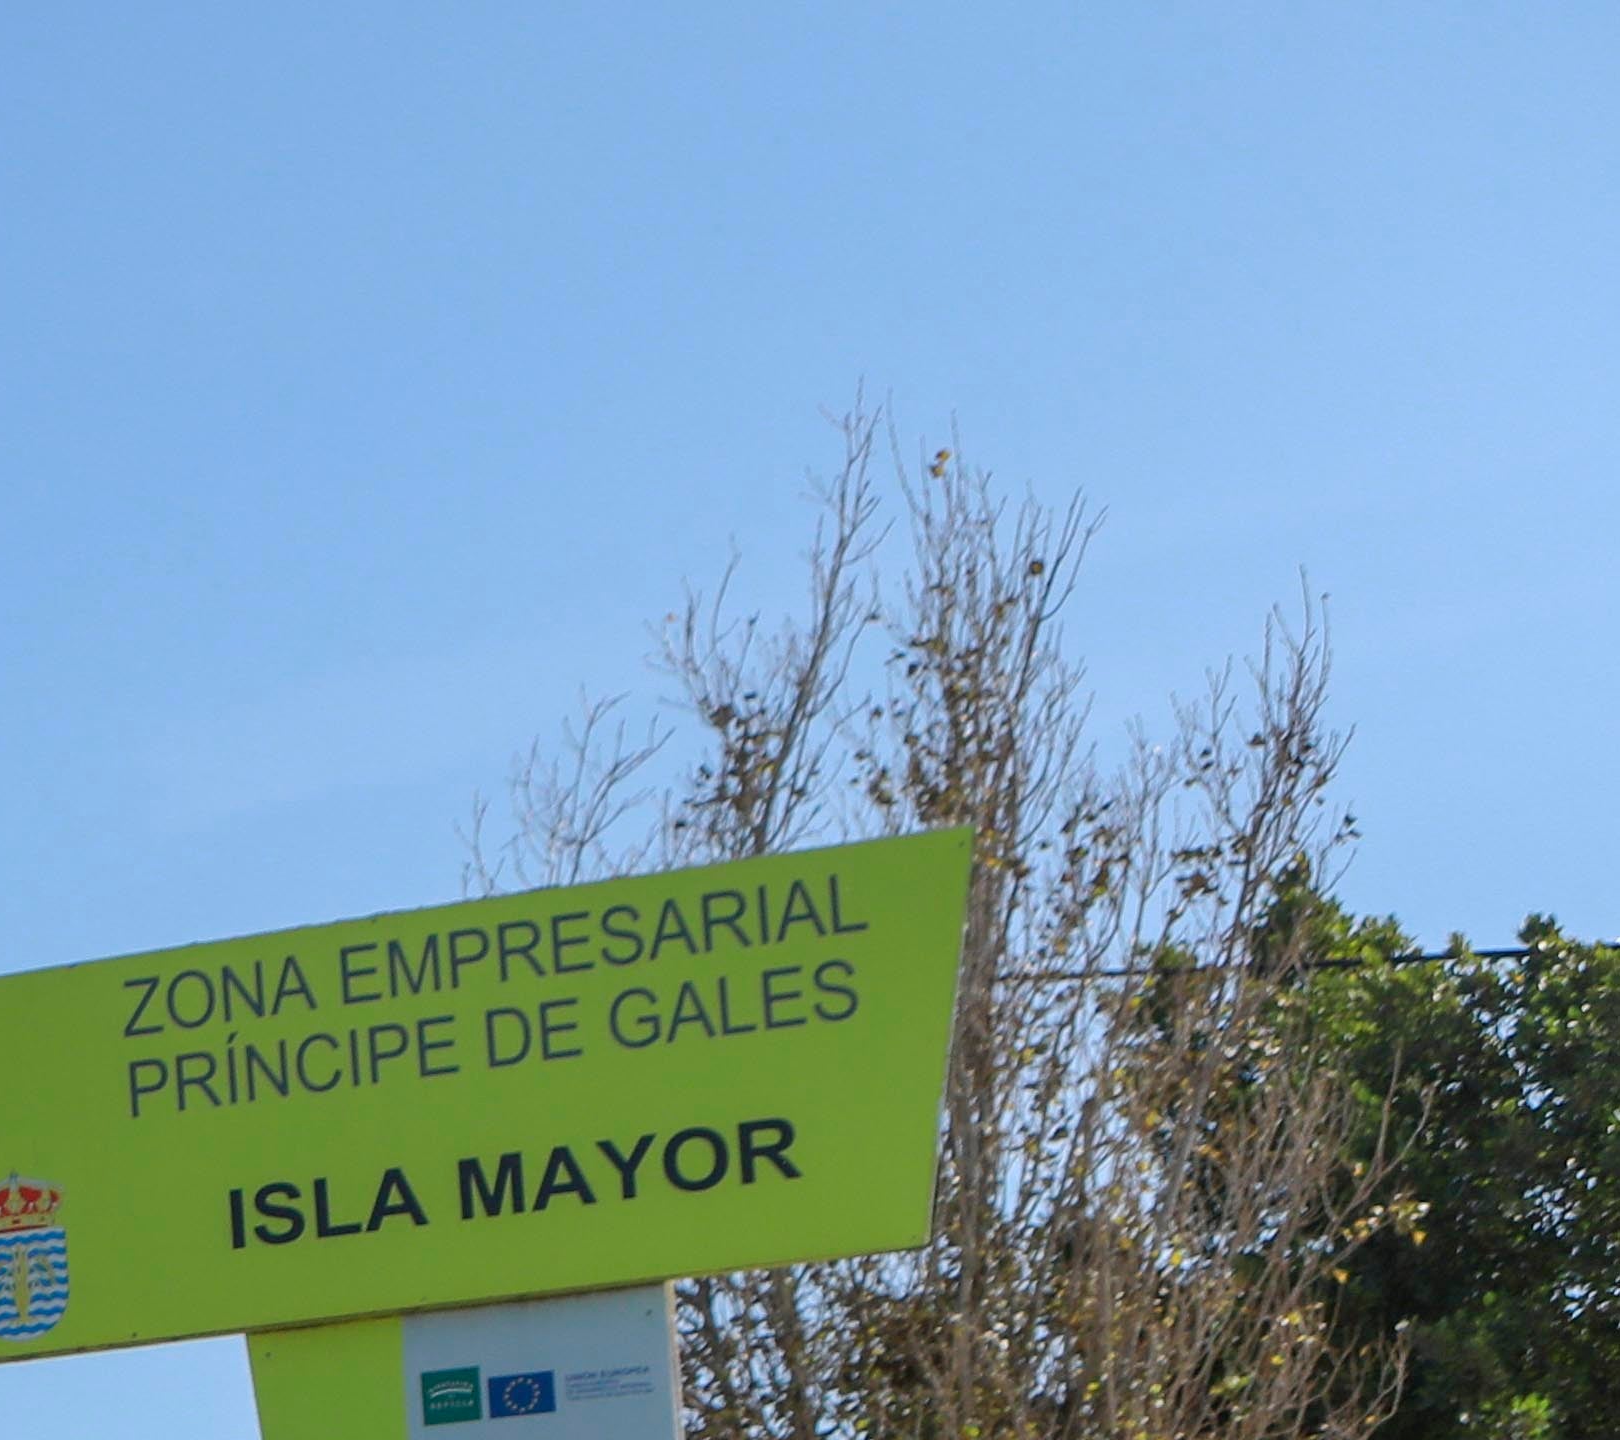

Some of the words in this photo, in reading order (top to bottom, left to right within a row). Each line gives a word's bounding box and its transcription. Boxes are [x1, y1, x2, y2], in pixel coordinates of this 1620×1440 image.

[123, 954, 318, 1038] ZONA
[339, 874, 869, 1006] EMPRESARIAL
[128, 1014, 461, 1118] PRÍNCIPE
[484, 997, 584, 1069] DE
[609, 959, 860, 1049] GALES
[228, 1166, 429, 1250] ISLA
[456, 1117, 803, 1220] MAYOR
